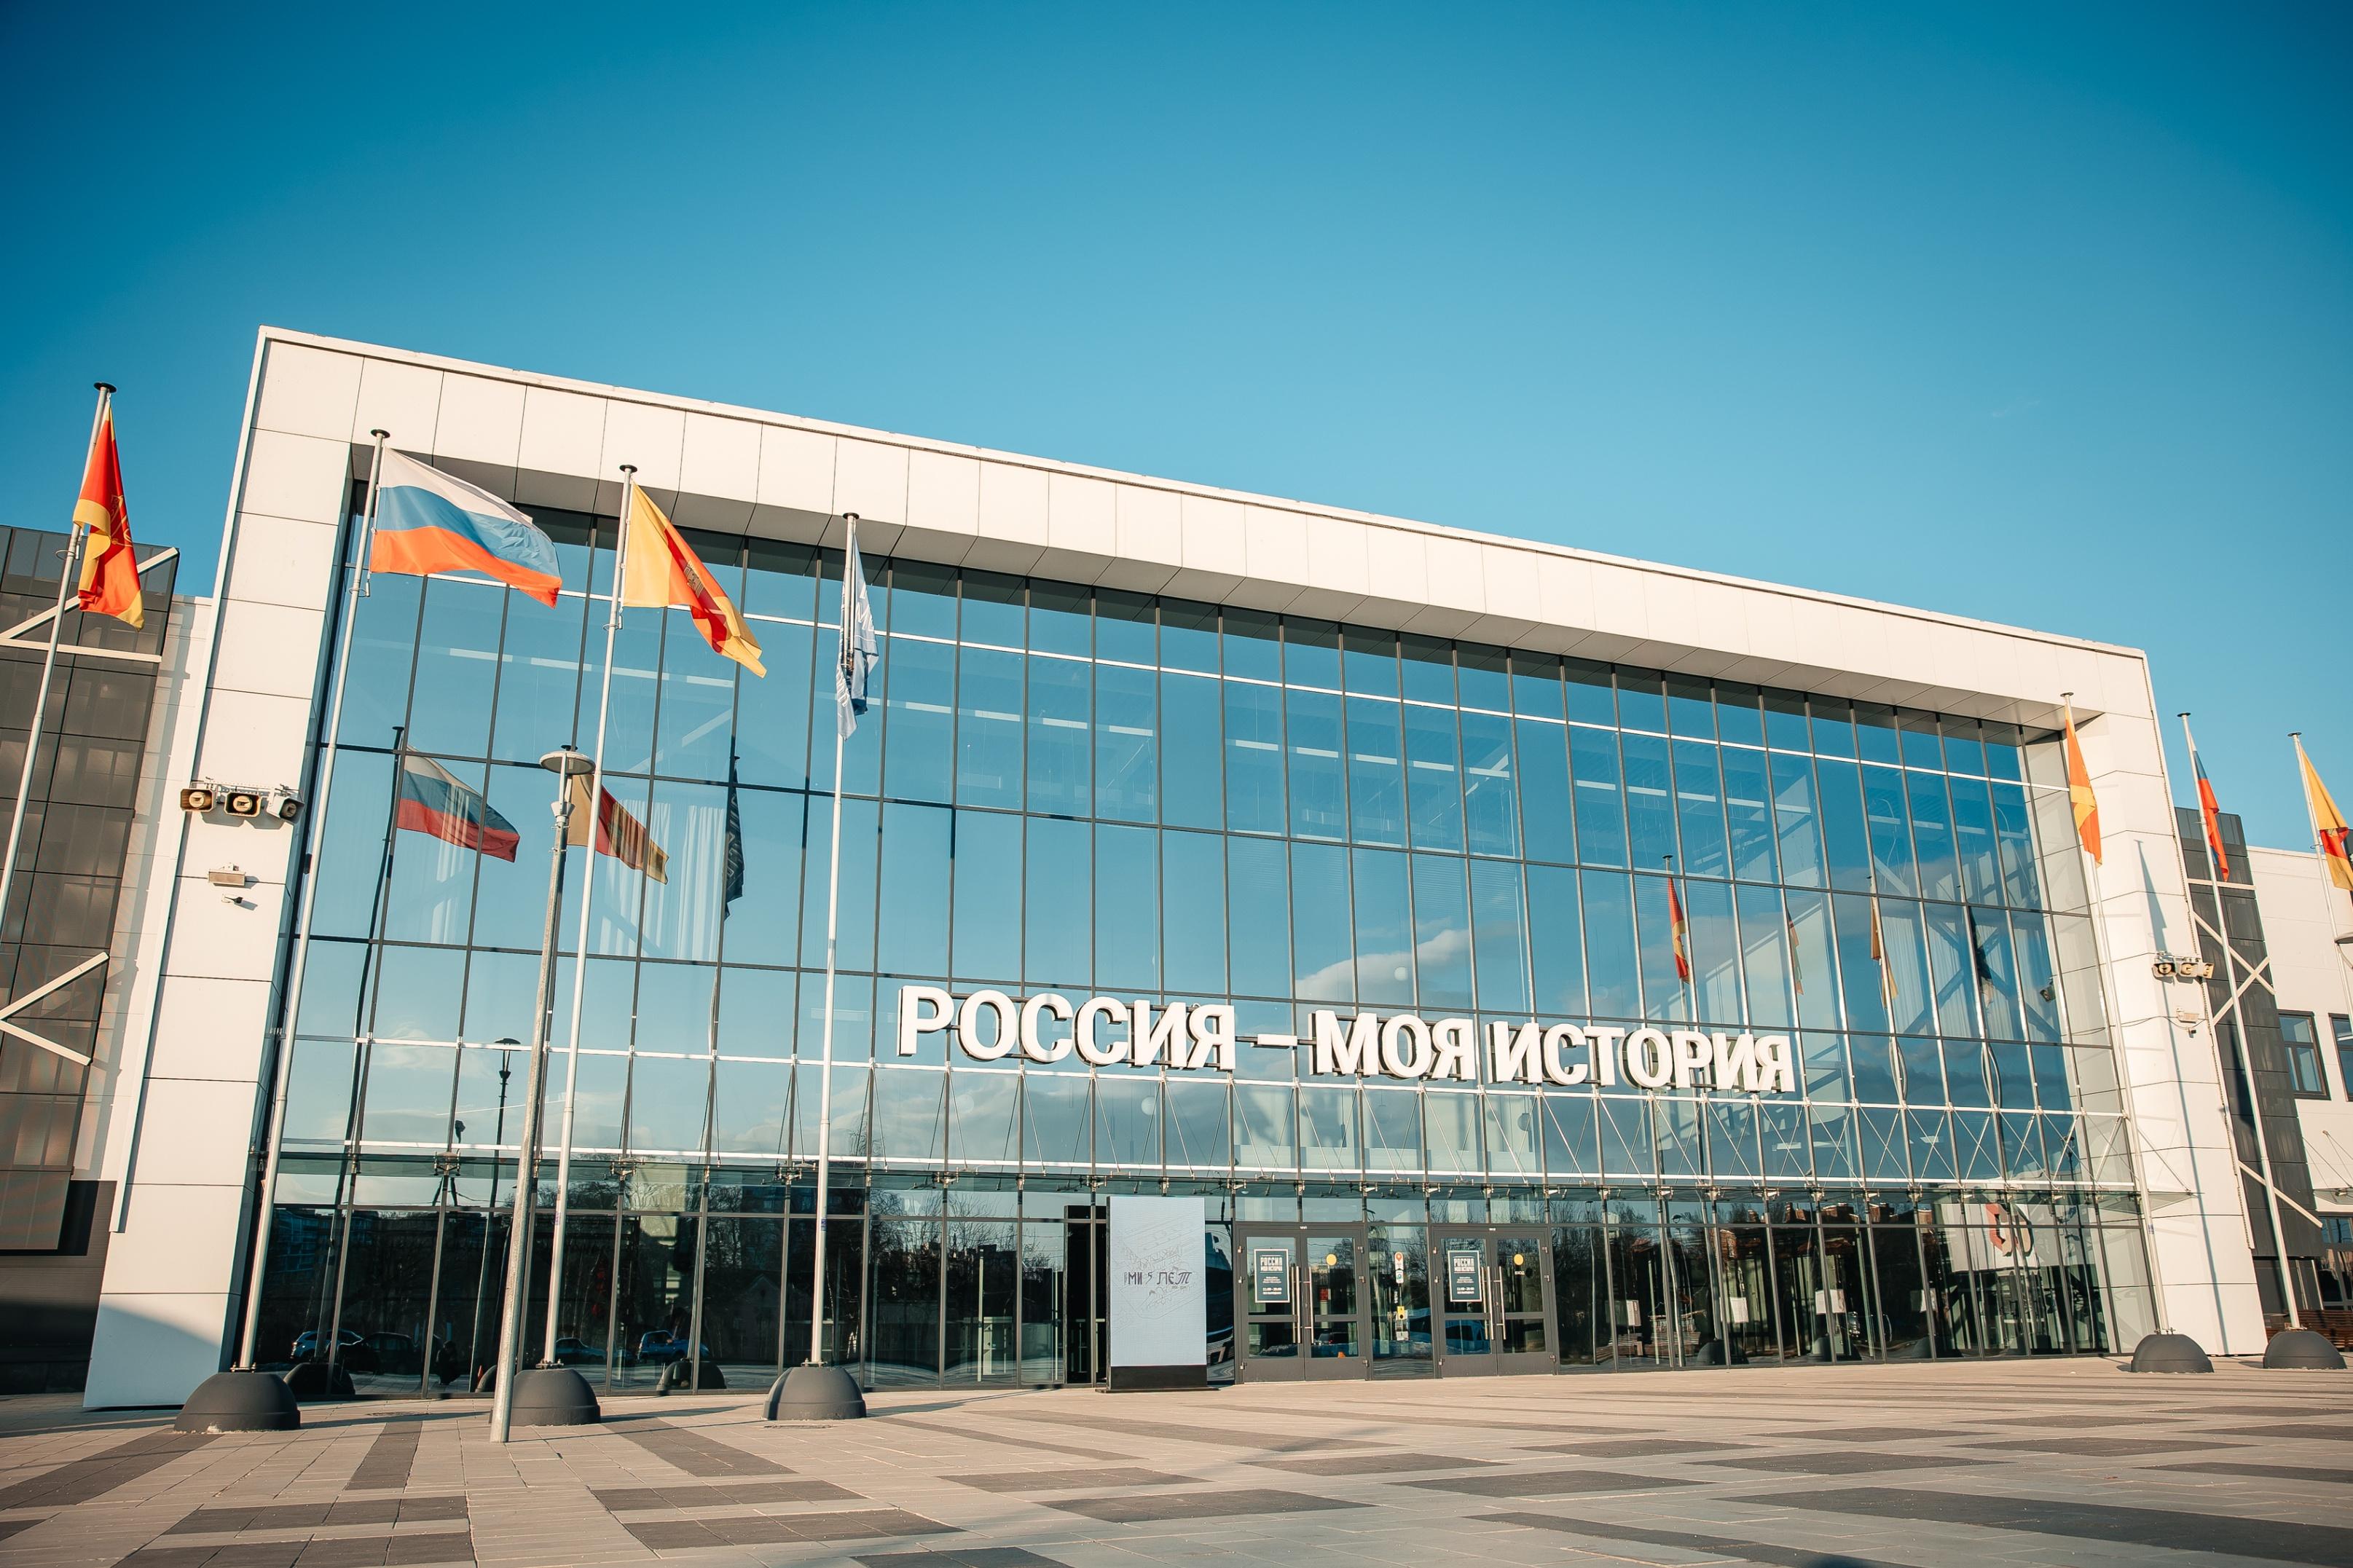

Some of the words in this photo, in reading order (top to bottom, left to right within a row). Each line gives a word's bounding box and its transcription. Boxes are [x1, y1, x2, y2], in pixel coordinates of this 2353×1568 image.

[897, 985, 1236, 1071] РОССИЯ
[1310, 1009, 1477, 1080] МОЯ
[1486, 1021, 1796, 1092] ИСТОРИЯ
[1156, 1272, 1193, 1285] ЛЕТ
